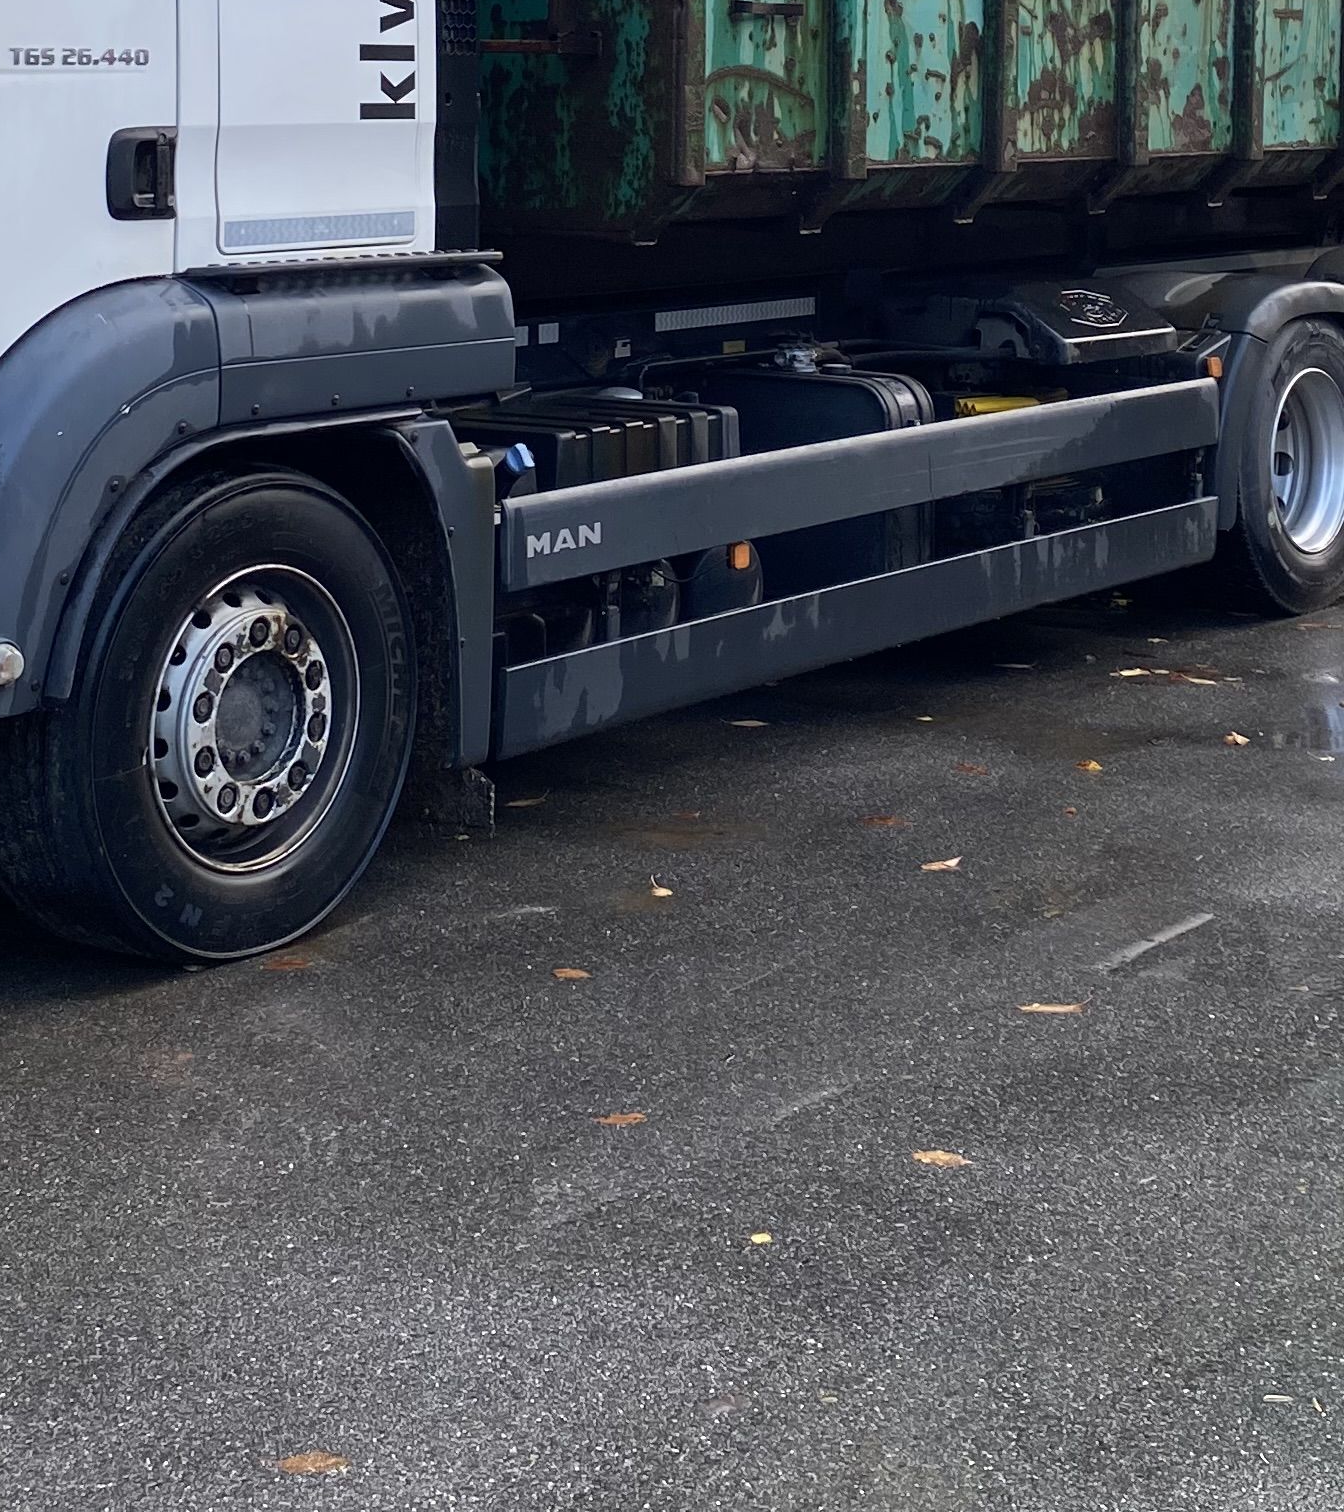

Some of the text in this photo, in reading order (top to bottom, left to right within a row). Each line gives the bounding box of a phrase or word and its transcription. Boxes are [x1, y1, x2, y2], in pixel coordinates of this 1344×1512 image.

[9, 47, 150, 66] TGS 26.440
[527, 521, 601, 558] MAN
